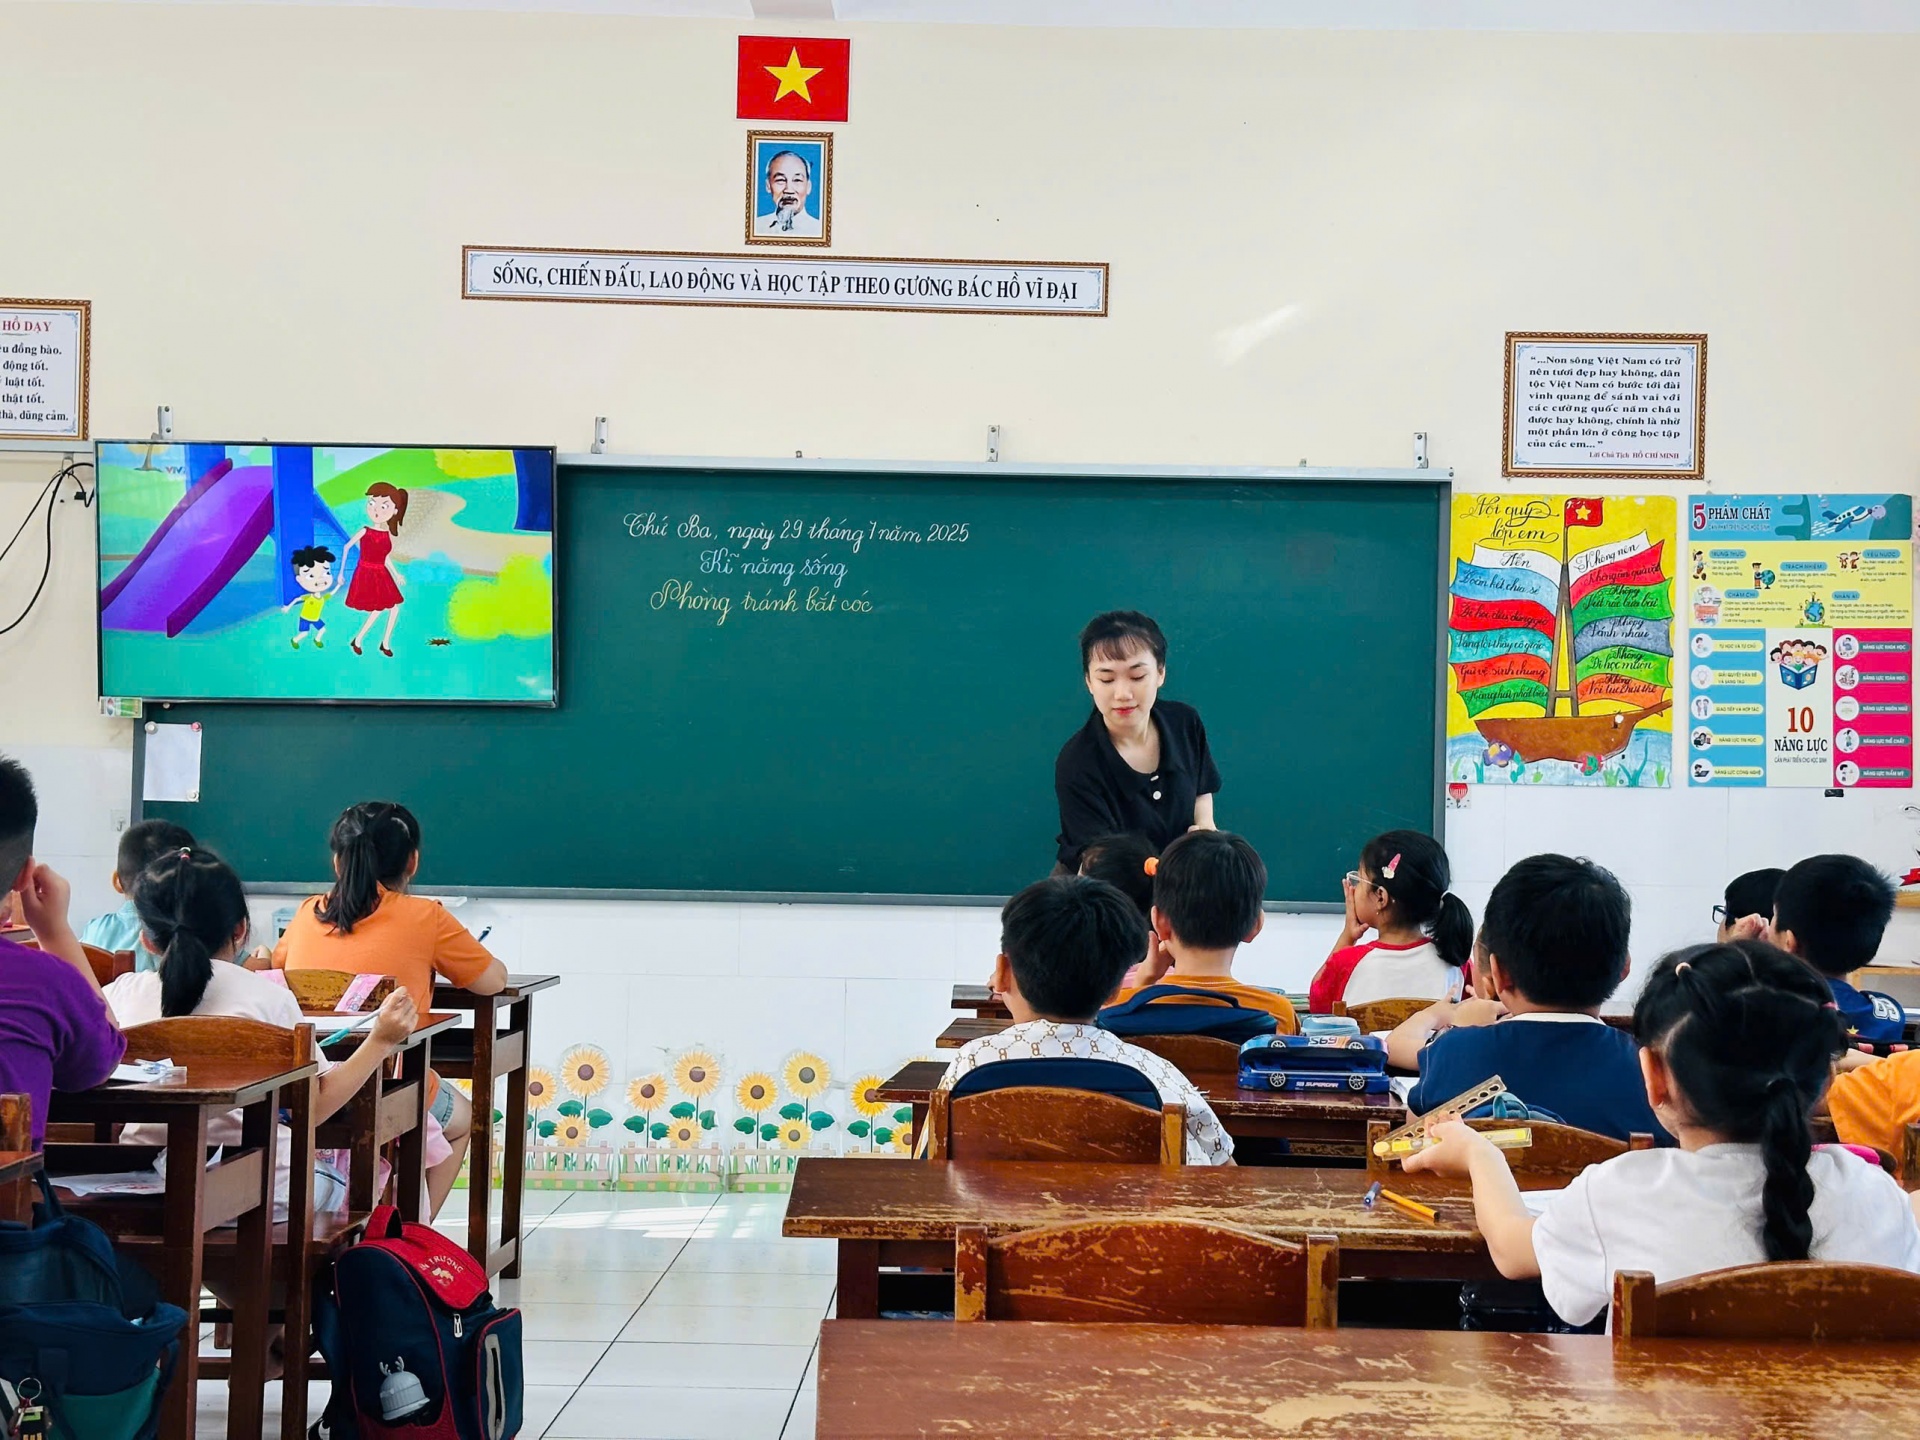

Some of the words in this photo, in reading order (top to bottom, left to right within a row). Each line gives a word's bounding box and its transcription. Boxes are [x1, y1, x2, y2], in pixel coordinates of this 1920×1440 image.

[492, 259, 543, 286] SỐNG,
[547, 261, 601, 287] CHIẾN
[605, 262, 645, 290] ĐẤU,
[649, 270, 683, 289] LAO
[687, 267, 735, 294] ĐỘNG
[740, 268, 762, 291] VÀ
[767, 274, 804, 296] HỌC
[807, 270, 841, 297] TẬP
[844, 276, 890, 295] THEO
[894, 275, 953, 297] GƯƠNG
[957, 274, 993, 298] BÁC
[996, 272, 1021, 299] HỒ
[1025, 277, 1043, 299] VĨ
[1046, 280, 1078, 303] ĐẠI
[24, 320, 51, 334] DẠY
[40, 345, 62, 355] bào.
[2, 360, 28, 372] động
[30, 360, 48, 371] tốt.
[1569, 356, 1594, 365] sông
[1597, 356, 1619, 365] Việt
[1622, 357, 1647, 365] Nam
[1649, 357, 1662, 365] có
[1664, 357, 1682, 365] trở
[1529, 368, 1549, 376] nên
[1552, 368, 1573, 376] tươi
[1576, 368, 1597, 378] đẹp
[1599, 369, 1618, 378] hay
[1621, 369, 1658, 378] không,
[1660, 369, 1681, 377] dân
[5, 376, 24, 388] luật
[27, 376, 45, 387] tốt.
[1529, 380, 1546, 389] tộc
[1549, 380, 1571, 389] Việt
[1575, 380, 1600, 388] Nam
[1602, 380, 1615, 389] có
[1618, 380, 1643, 389] bước
[1646, 381, 1661, 389] tới
[1663, 381, 1680, 389] đài
[2, 393, 23, 405] thật
[26, 393, 45, 404] tốt.
[1529, 392, 1553, 400] vinh
[1556, 393, 1591, 401] quang
[1594, 391, 1608, 401] để
[1611, 392, 1639, 401] sánh
[1642, 393, 1659, 401] vai
[1662, 393, 1680, 401] với
[1528, 403, 1549, 412] các
[1551, 404, 1588, 413] cường
[1590, 403, 1619, 414] quốc
[1651, 405, 1681, 413] châu
[19, 410, 43, 422] dũng
[45, 410, 69, 421] cảm.
[1527, 416, 1553, 425] được
[1556, 416, 1575, 425] hay
[1577, 416, 1613, 426] không,
[1615, 417, 1645, 425] chính
[1647, 417, 1657, 425] là
[1660, 417, 1681, 425] nhờ
[1527, 428, 1549, 437] một
[1552, 426, 1579, 437] phần
[1581, 428, 1599, 436] lớn
[1611, 429, 1637, 438] công
[1640, 429, 1659, 438] học
[1662, 430, 1681, 439] tập
[1527, 439, 1546, 448] của
[1549, 440, 1567, 448] các
[1644, 451, 1658, 459] CHÍ
[1693, 503, 1706, 530] 5
[1708, 501, 1739, 520] PHẨM
[1742, 501, 1771, 520] CHẤT
[623, 512, 668, 538] Thứ
[677, 514, 719, 540] Ba,
[727, 521, 775, 550] ngày
[780, 519, 803, 539] 29
[808, 517, 863, 553] tháng
[868, 520, 877, 539] 7
[878, 523, 922, 543] năm
[926, 523, 970, 543] 2025
[1509, 529, 1560, 546] em
[740, 557, 796, 586] năng
[800, 553, 848, 588] sống
[650, 578, 731, 626] Phòng
[741, 588, 799, 613] tránh
[805, 586, 835, 613] bắt
[841, 590, 873, 613] cóc
[1787, 706, 1814, 733] 10
[1774, 735, 1804, 752] NĂNG
[1806, 736, 1828, 755] LỰC
